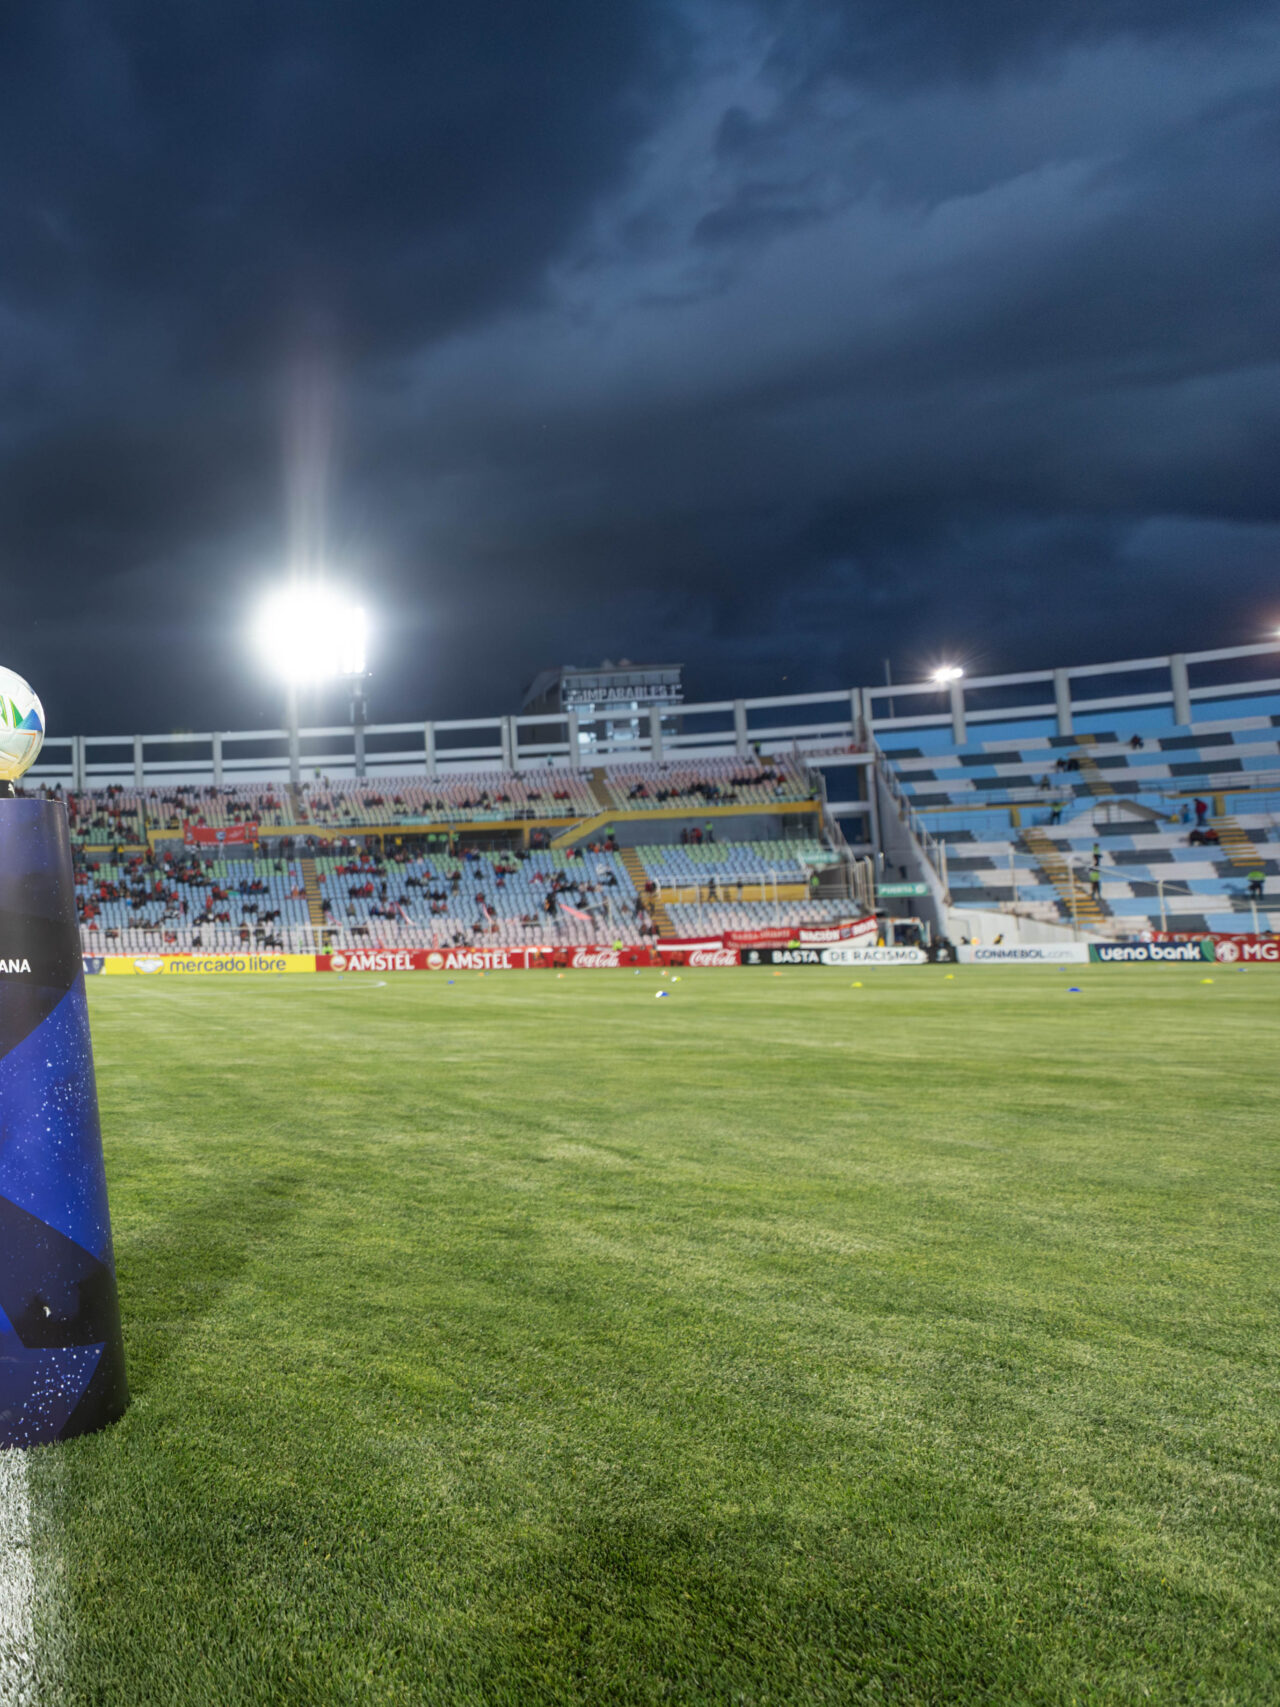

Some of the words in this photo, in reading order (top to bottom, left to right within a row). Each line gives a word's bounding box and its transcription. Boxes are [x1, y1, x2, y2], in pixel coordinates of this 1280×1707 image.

[772, 950, 820, 963] BASTA
[830, 951, 848, 962] DE
[853, 949, 920, 962] RACISMO
[1100, 946, 1148, 961] ueno
[1148, 943, 1201, 960] bank
[1243, 943, 1279, 960] MG
[170, 958, 245, 972] mercado
[249, 957, 286, 971] libre
[348, 953, 415, 971] AMSTEL
[445, 952, 512, 970] AMSTEL
